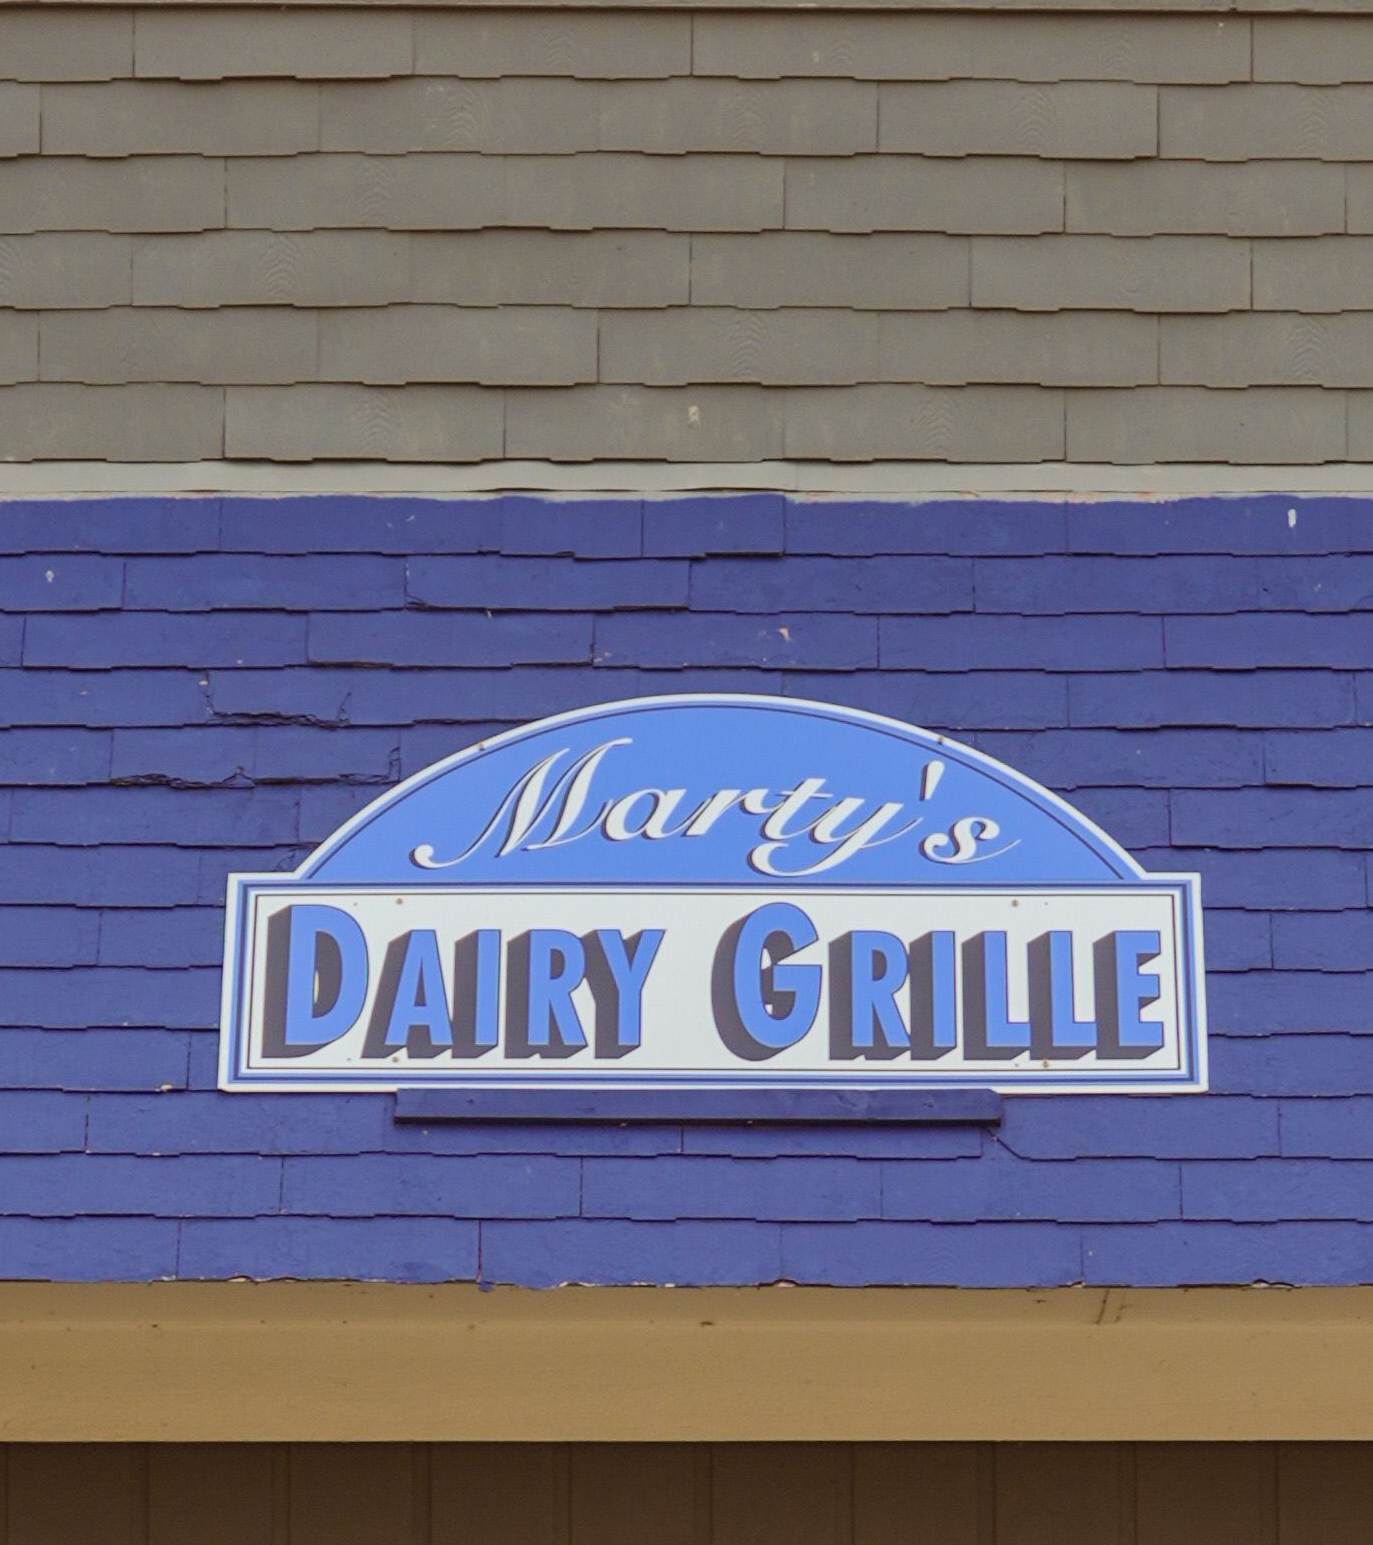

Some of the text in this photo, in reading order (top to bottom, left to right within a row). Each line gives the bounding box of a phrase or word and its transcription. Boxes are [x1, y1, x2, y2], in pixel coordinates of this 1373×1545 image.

[412, 737, 1022, 878] Marty's
[264, 902, 1164, 1059] DAIRY GRILLE
